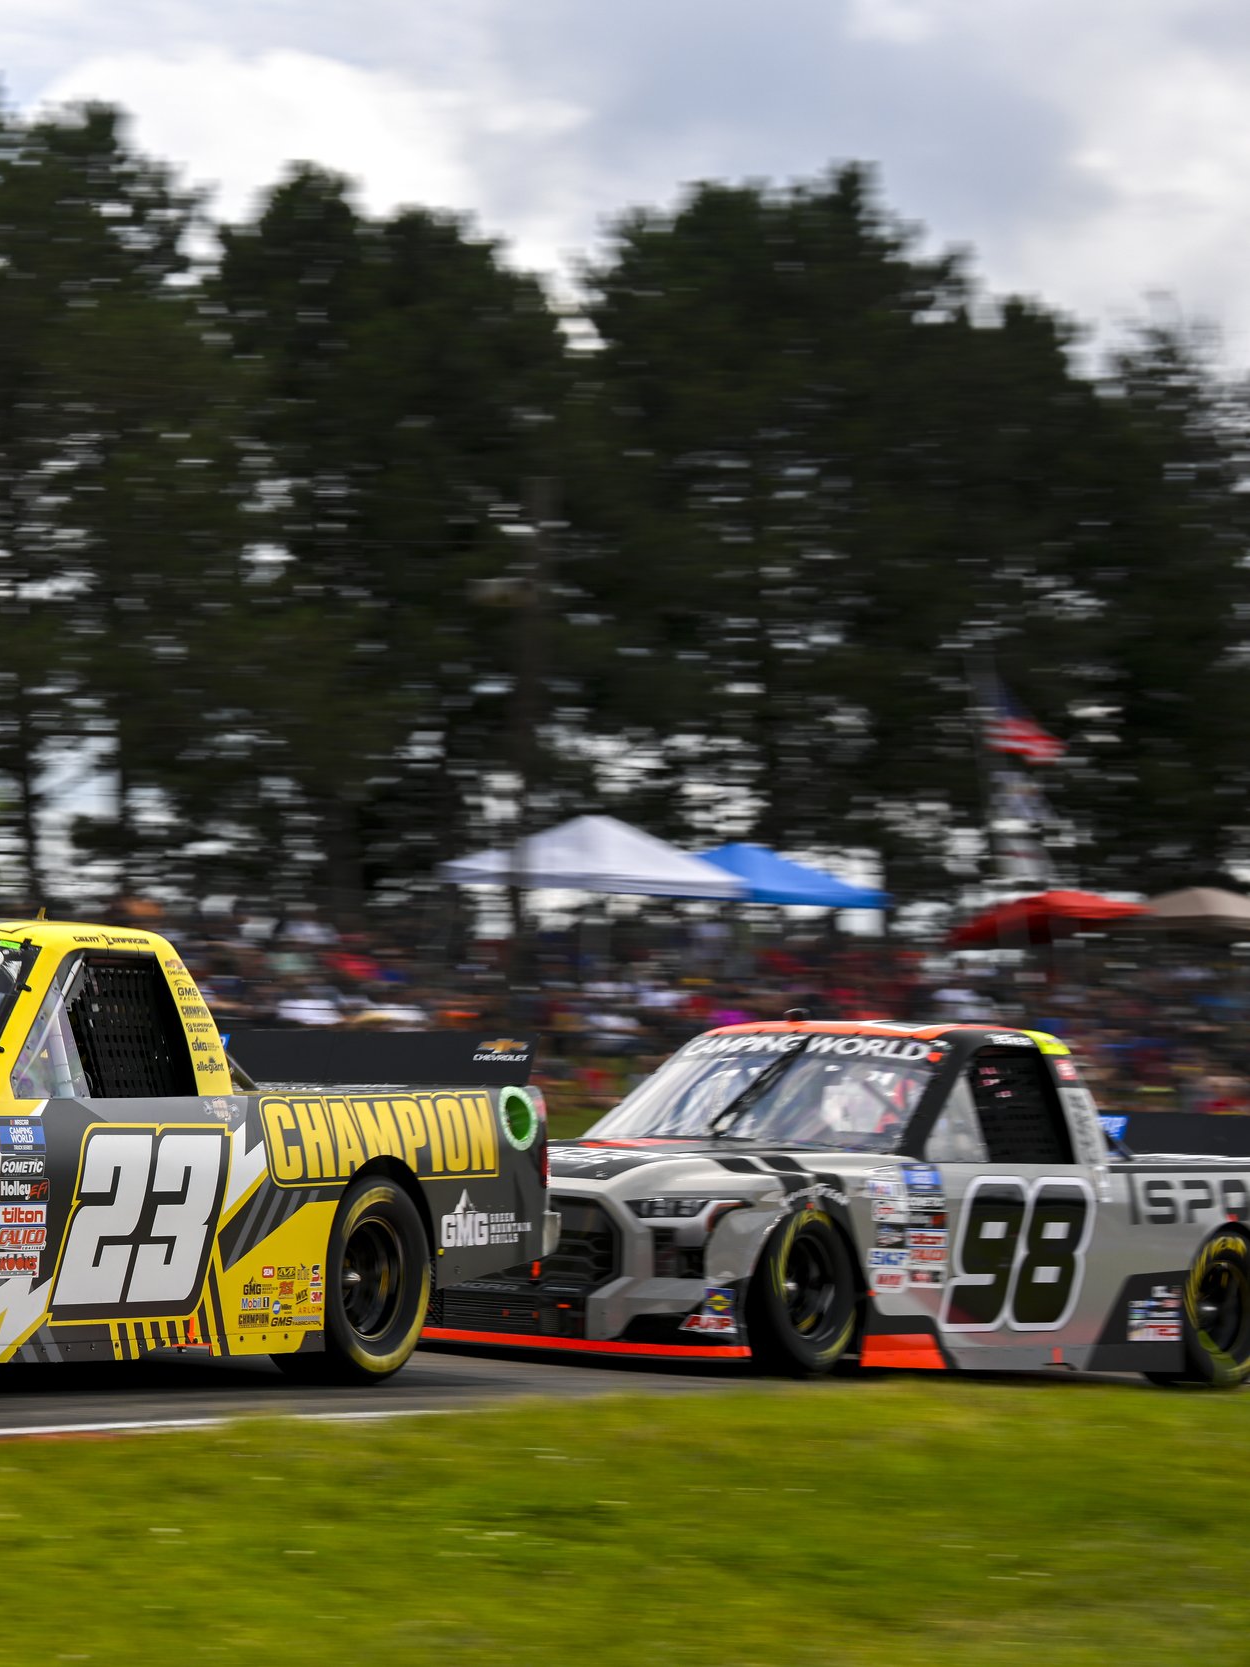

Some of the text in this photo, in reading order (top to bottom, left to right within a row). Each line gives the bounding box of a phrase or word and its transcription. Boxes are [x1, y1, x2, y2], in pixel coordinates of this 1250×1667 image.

[683, 1035, 931, 1061] CAMPING WORLD
[472, 1053, 529, 1061] CHEVROLET
[196, 1060, 225, 1073] allegiant
[9, 1127, 33, 1135] CAMPING
[11, 1134, 34, 1144] WORLD
[263, 1096, 497, 1180] CHAMPION
[1, 1160, 44, 1174] COMETIC
[0, 1180, 30, 1200] Holley
[2, 1208, 44, 1224] tilton
[52, 1134, 222, 1306] 23
[441, 1212, 489, 1248] GMG
[941, 1178, 1095, 1330] 98
[296, 1288, 308, 1301] WIX
[311, 1292, 322, 1302] 3M
[242, 1298, 262, 1309] Mobil
[238, 1314, 270, 1325] CHAMPION
[270, 1316, 292, 1327] GMS
